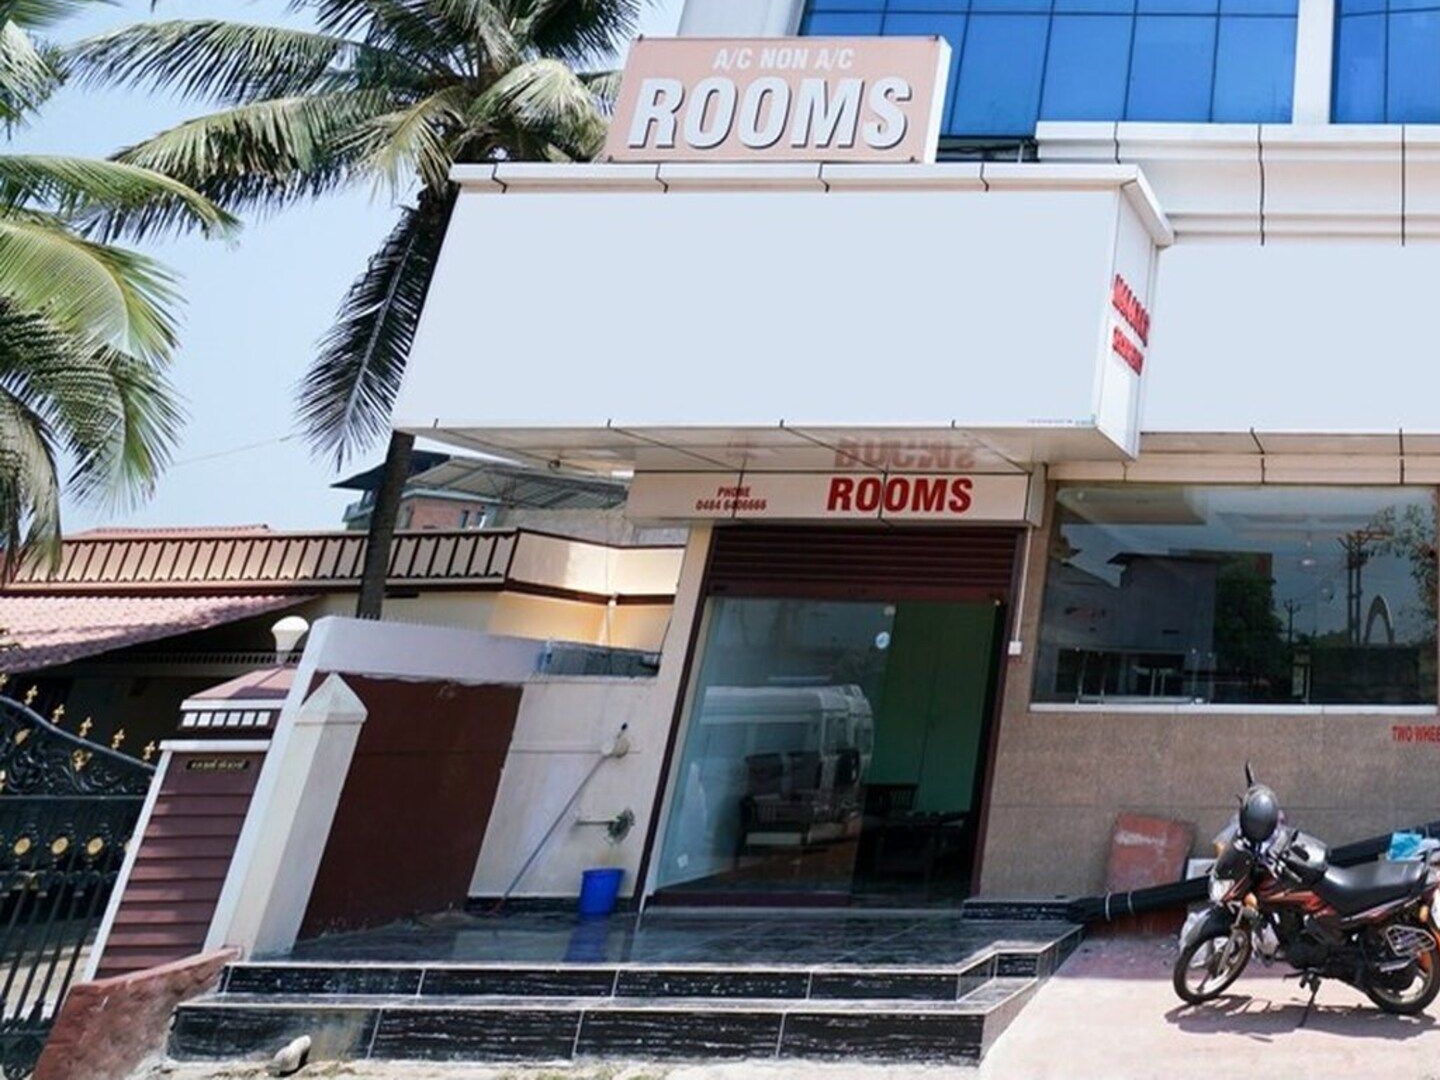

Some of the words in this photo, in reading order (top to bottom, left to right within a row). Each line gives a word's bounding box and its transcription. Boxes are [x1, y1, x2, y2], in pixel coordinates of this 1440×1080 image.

[713, 48, 753, 70] A/C
[759, 48, 810, 69] NON
[815, 48, 855, 70] A/C
[627, 76, 913, 150] ROOMS
[827, 477, 973, 513] ROOMS
[1393, 726, 1412, 742] TWO
